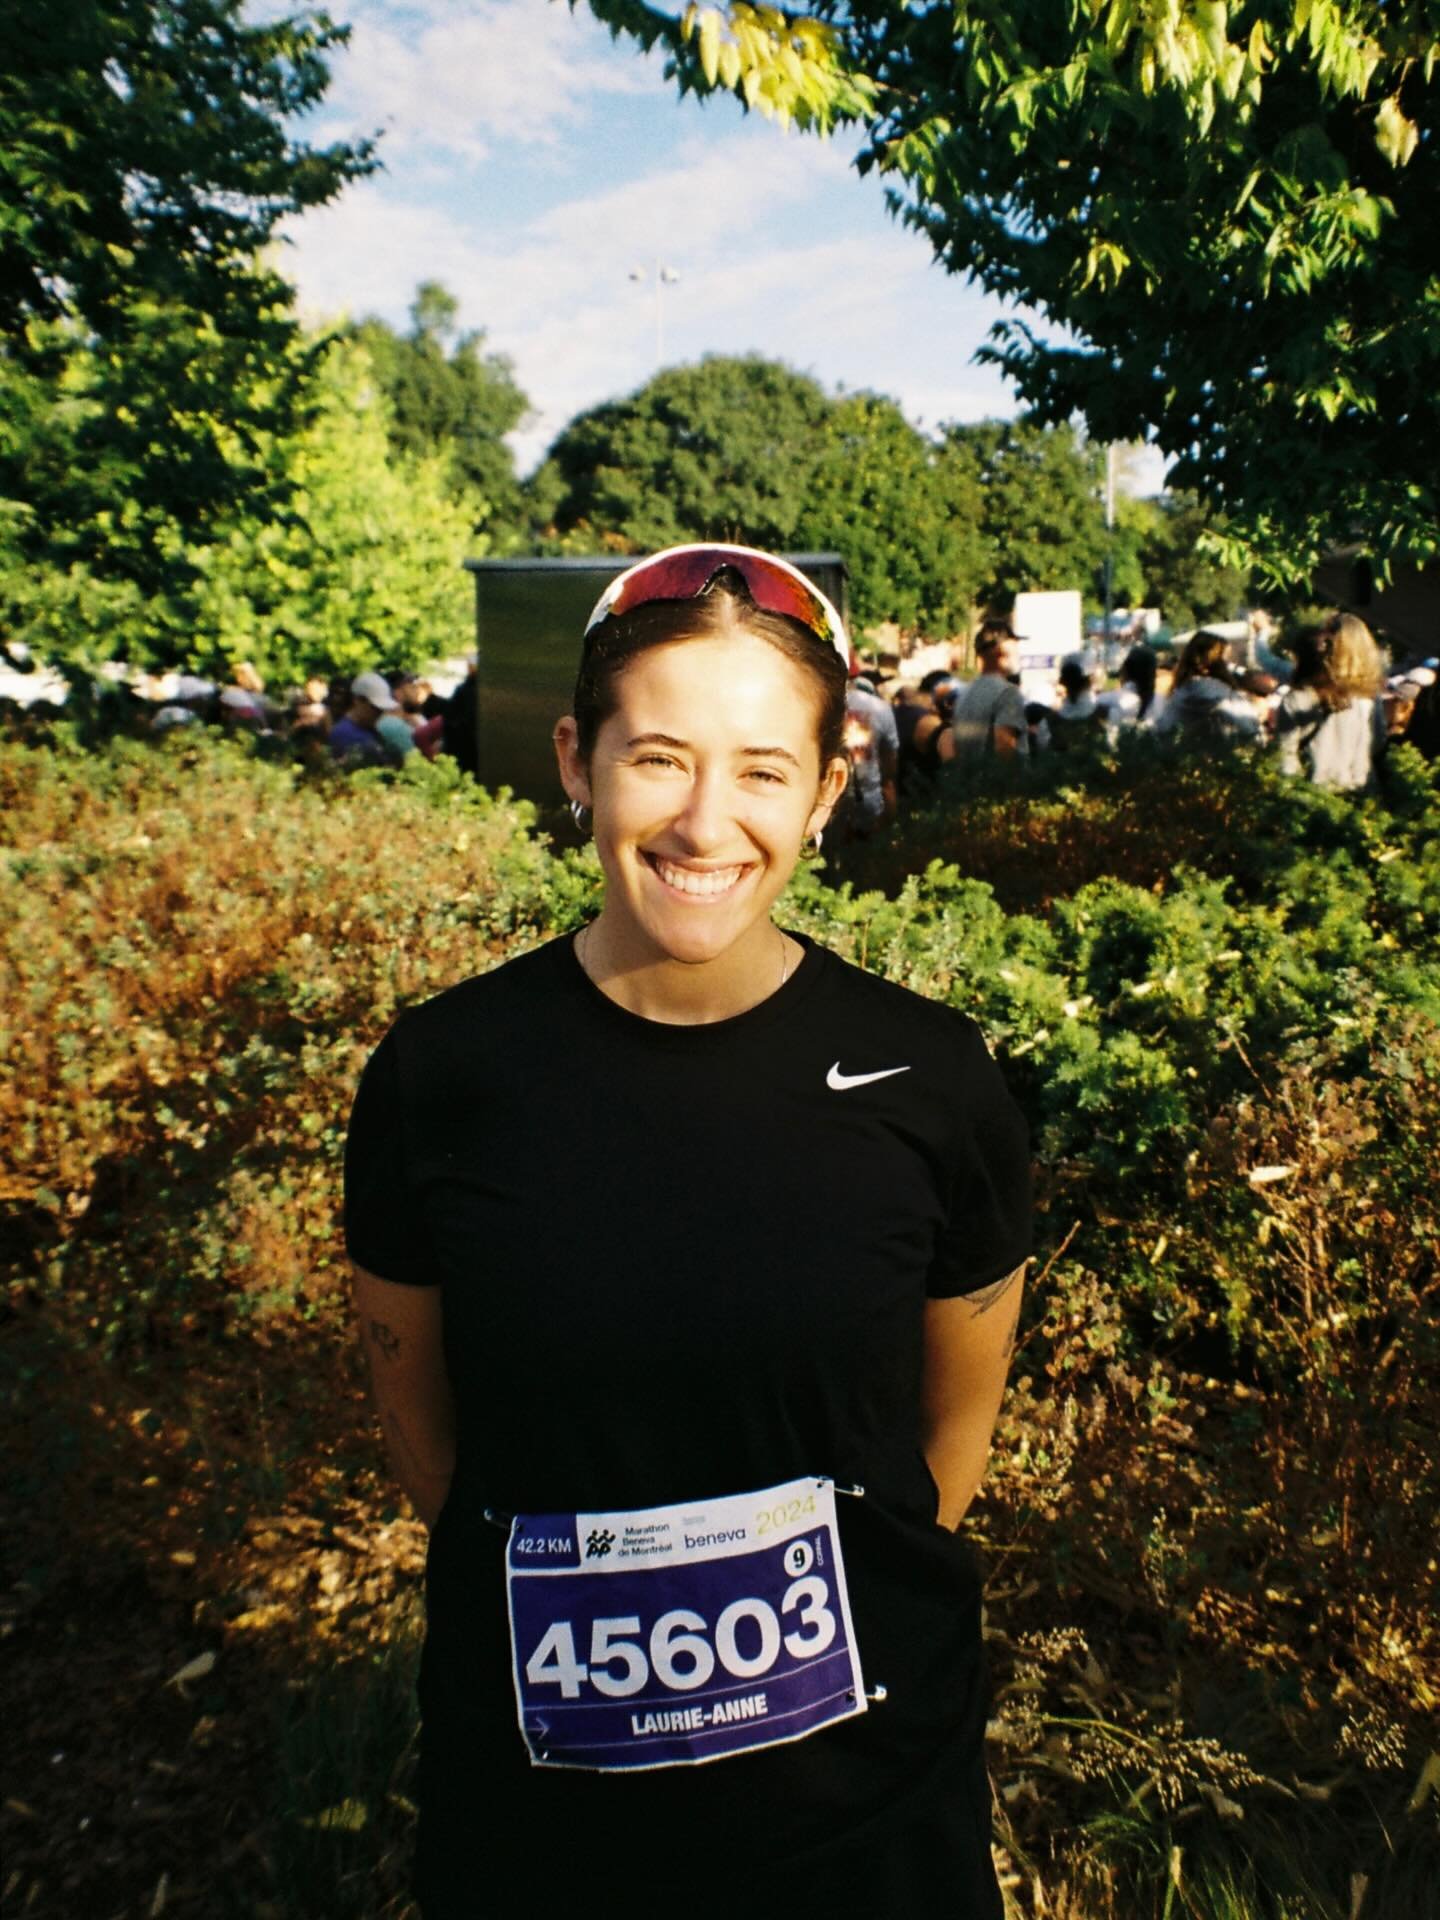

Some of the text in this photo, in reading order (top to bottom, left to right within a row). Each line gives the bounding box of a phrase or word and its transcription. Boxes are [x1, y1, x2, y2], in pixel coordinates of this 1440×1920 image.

[756, 1495, 816, 1535] 2024
[625, 1523, 670, 1536] Marathon
[684, 1528, 746, 1549] beneva
[516, 1537, 572, 1553] 42.2 KM
[622, 1536, 655, 1546] Beneva
[618, 1548, 630, 1557] de
[793, 1547, 805, 1568] 9
[526, 1576, 836, 1699] 45603
[631, 1693, 769, 1736] LAURIE-ANNE
